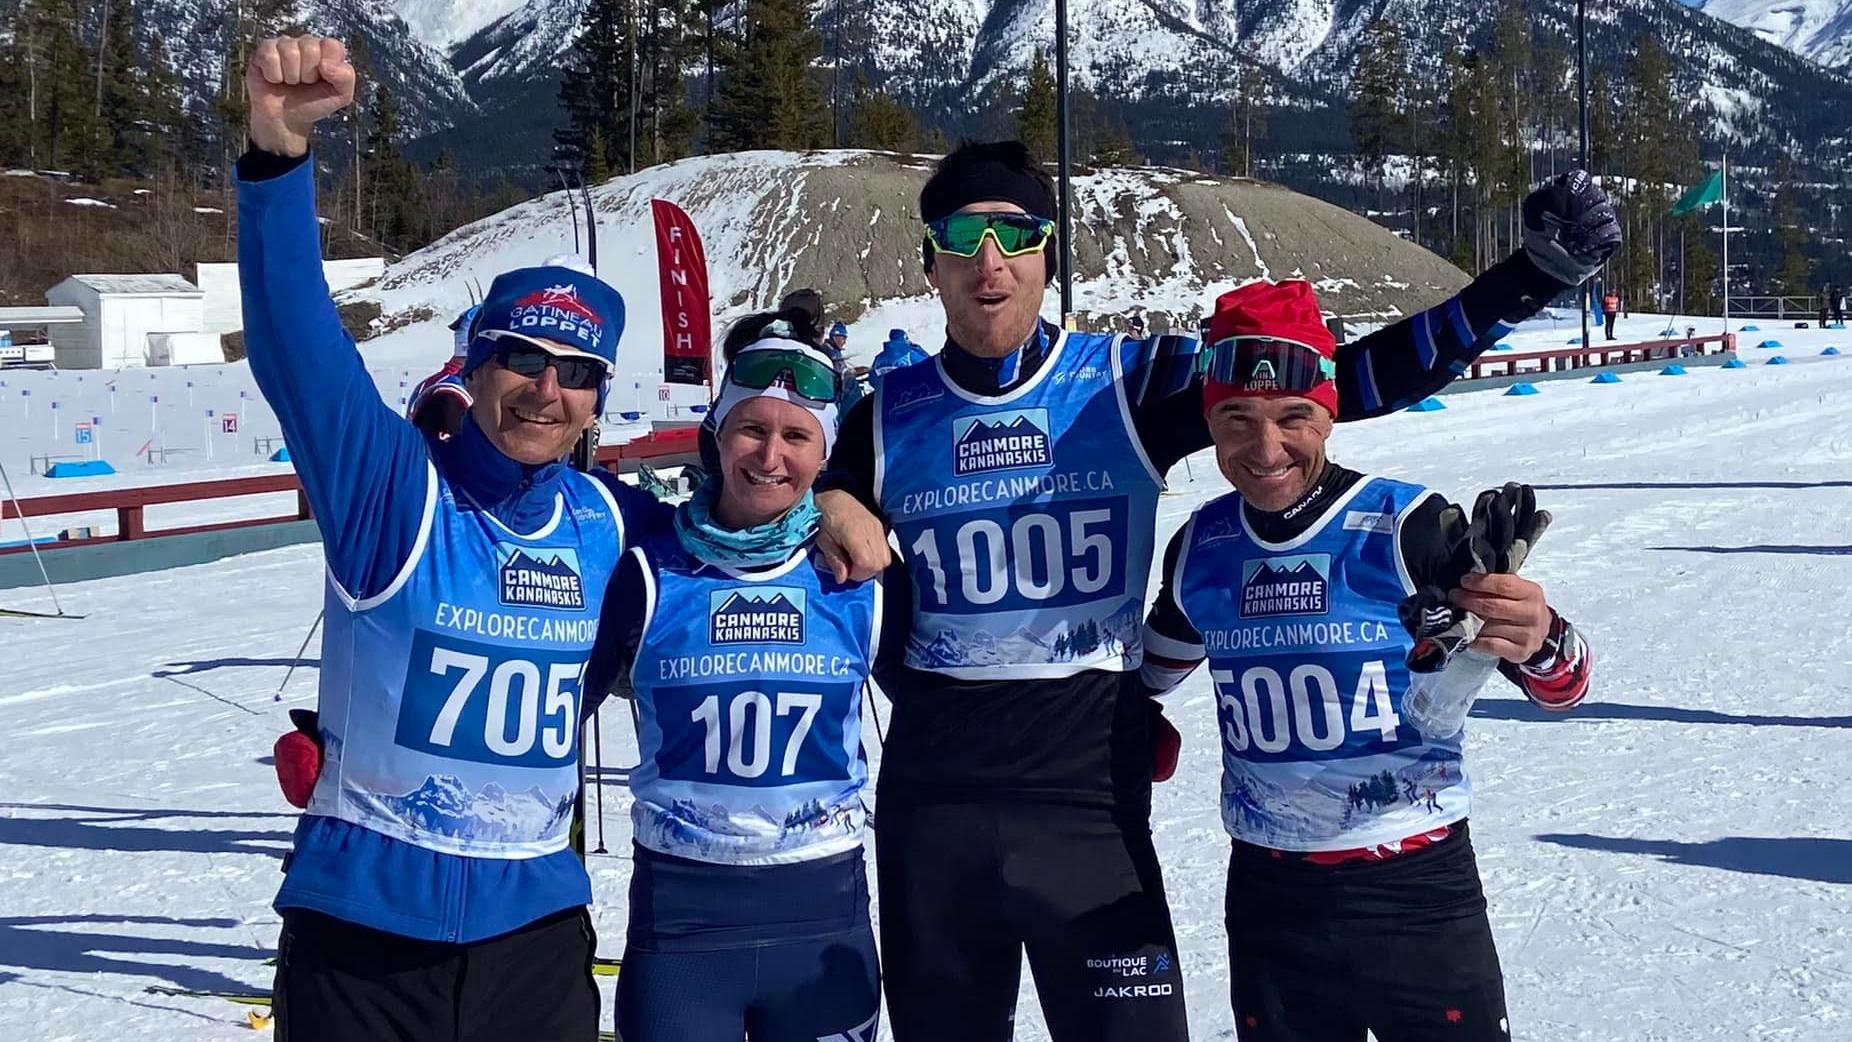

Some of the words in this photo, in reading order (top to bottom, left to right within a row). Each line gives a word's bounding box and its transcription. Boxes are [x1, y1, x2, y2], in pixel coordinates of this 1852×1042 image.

[669, 226, 692, 350] FINISH
[509, 315, 601, 348] LOPPET
[510, 304, 603, 338] GATINEAU
[77, 429, 91, 443] 15
[223, 419, 236, 432] 14
[959, 435, 1045, 458] CANMORE
[959, 449, 1046, 472] KANANASKIS
[903, 470, 1114, 514] EXPLORECANMORE.CA
[911, 507, 1113, 605] 1005
[505, 569, 580, 591] CANMORE
[1245, 580, 1323, 600] CANMORE
[505, 586, 582, 606] KANANASKIS
[1243, 596, 1322, 614] KANANASKIS
[715, 612, 800, 628] CANMORE
[715, 627, 801, 641] KANANASKIS
[1204, 620, 1389, 651] EXPLORECANMORE.CA
[659, 651, 850, 680] EXPLORECANMORE.CA
[429, 646, 583, 759] 705
[1211, 660, 1400, 754] 5004
[691, 690, 823, 779] 107
[1086, 956, 1148, 968] BOUTIQUE
[1122, 966, 1148, 977] LAC
[1093, 983, 1173, 998] JAKROO
